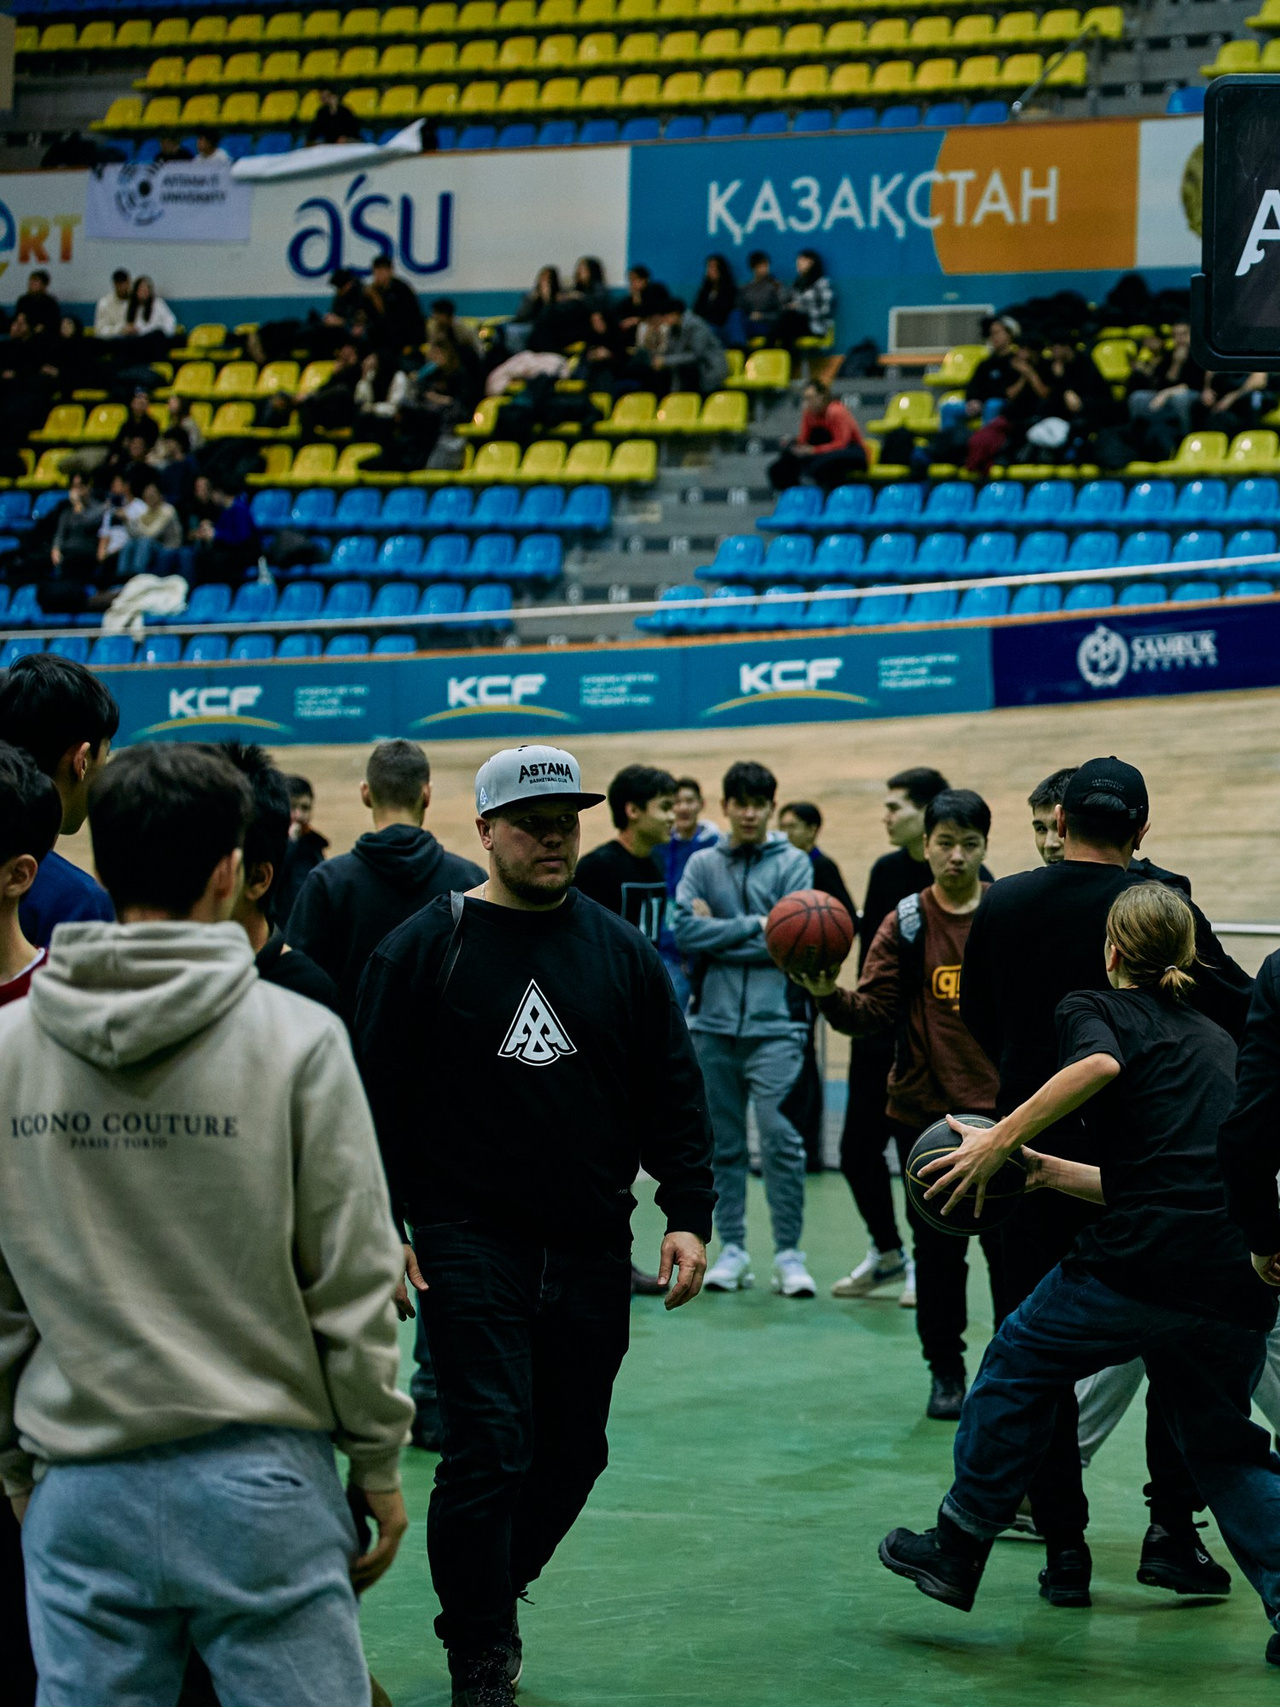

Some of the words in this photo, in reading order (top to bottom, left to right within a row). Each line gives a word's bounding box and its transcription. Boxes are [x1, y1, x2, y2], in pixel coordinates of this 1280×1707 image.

[707, 166, 1059, 245] ҚАЗАҚСТАН
[448, 673, 547, 708] KCF
[740, 657, 843, 694] KCF
[169, 684, 263, 718] KCF
[518, 762, 574, 784] ASTANA
[11, 1112, 92, 1138] ICONO
[102, 1111, 239, 1138] COUTURE
